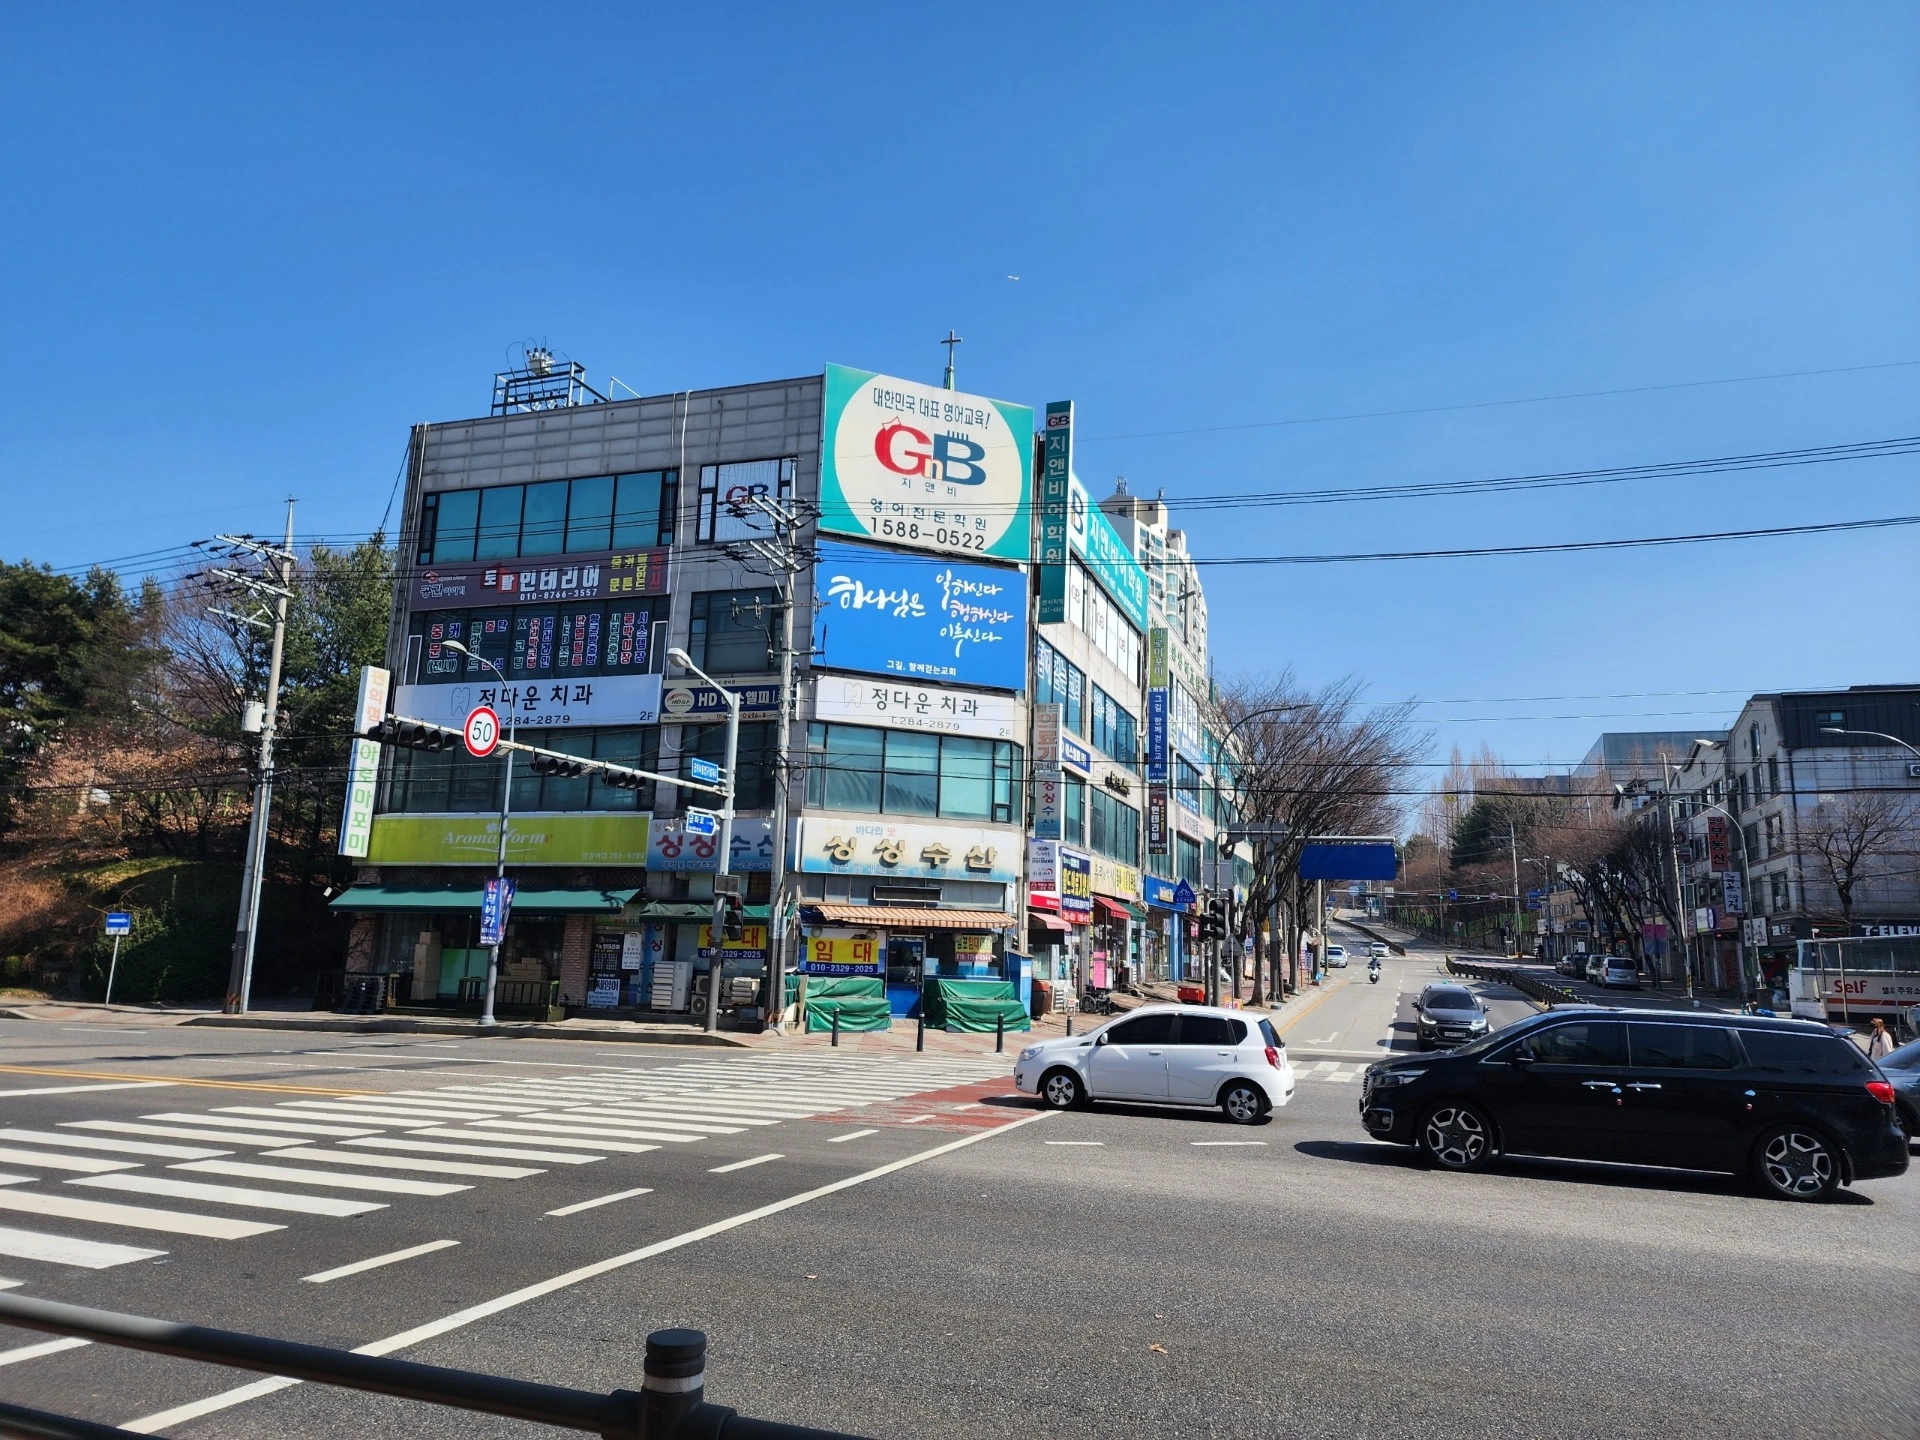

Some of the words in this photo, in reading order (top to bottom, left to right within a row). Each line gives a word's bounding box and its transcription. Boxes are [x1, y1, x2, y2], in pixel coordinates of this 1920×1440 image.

[873, 387, 915, 414] 대한민국
[919, 397, 940, 419] 대표
[943, 402, 991, 429] 영어교육!
[1045, 436, 1065, 565] 지앤비어학원
[870, 517, 985, 551] 1588-0522
[520, 588, 597, 601] 010-8766-3557
[827, 575, 926, 618] 하나님은
[936, 569, 1004, 611] 일하신다
[634, 611, 649, 664] 시스템장
[479, 685, 541, 711] 정다운
[550, 683, 593, 706] 치과
[698, 692, 717, 707] HD
[871, 688, 932, 715] 정다운
[941, 695, 979, 717] 치과
[639, 711, 654, 722] 2F
[890, 716, 960, 731] T.284-2879
[472, 720, 492, 743] 50
[999, 727, 1011, 737] 2F
[1037, 712, 1058, 761] 의료기
[347, 743, 378, 854] 아로마포미
[441, 831, 498, 844] Aroma
[855, 825, 883, 836] 바다의
[886, 827, 896, 837] 맛
[825, 835, 998, 869] 싱싱수산
[1711, 827, 1727, 865] 부동산
[1861, 925, 1920, 936] 7-ELEV
[810, 963, 874, 973] 010-2329-2025
[1834, 980, 1868, 994] Self
